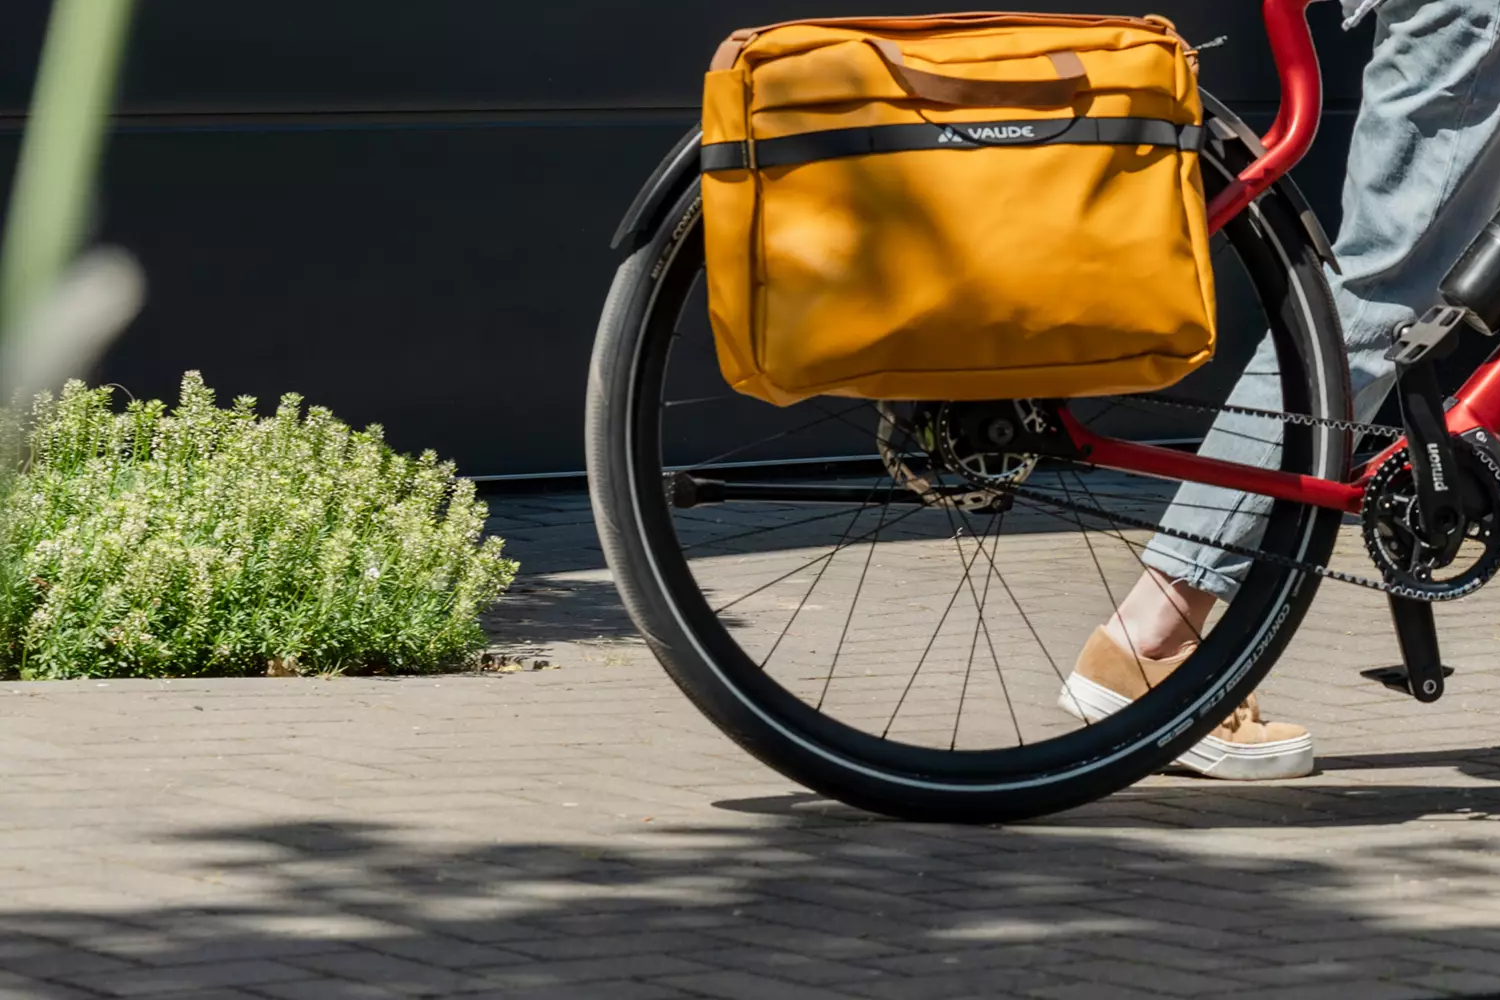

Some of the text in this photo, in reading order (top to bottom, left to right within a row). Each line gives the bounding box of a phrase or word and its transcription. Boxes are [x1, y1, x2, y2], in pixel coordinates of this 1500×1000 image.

[968, 126, 1035, 140] VAUDE
[1426, 443, 1449, 491] pinion
[1253, 604, 1290, 662] CONTACT
